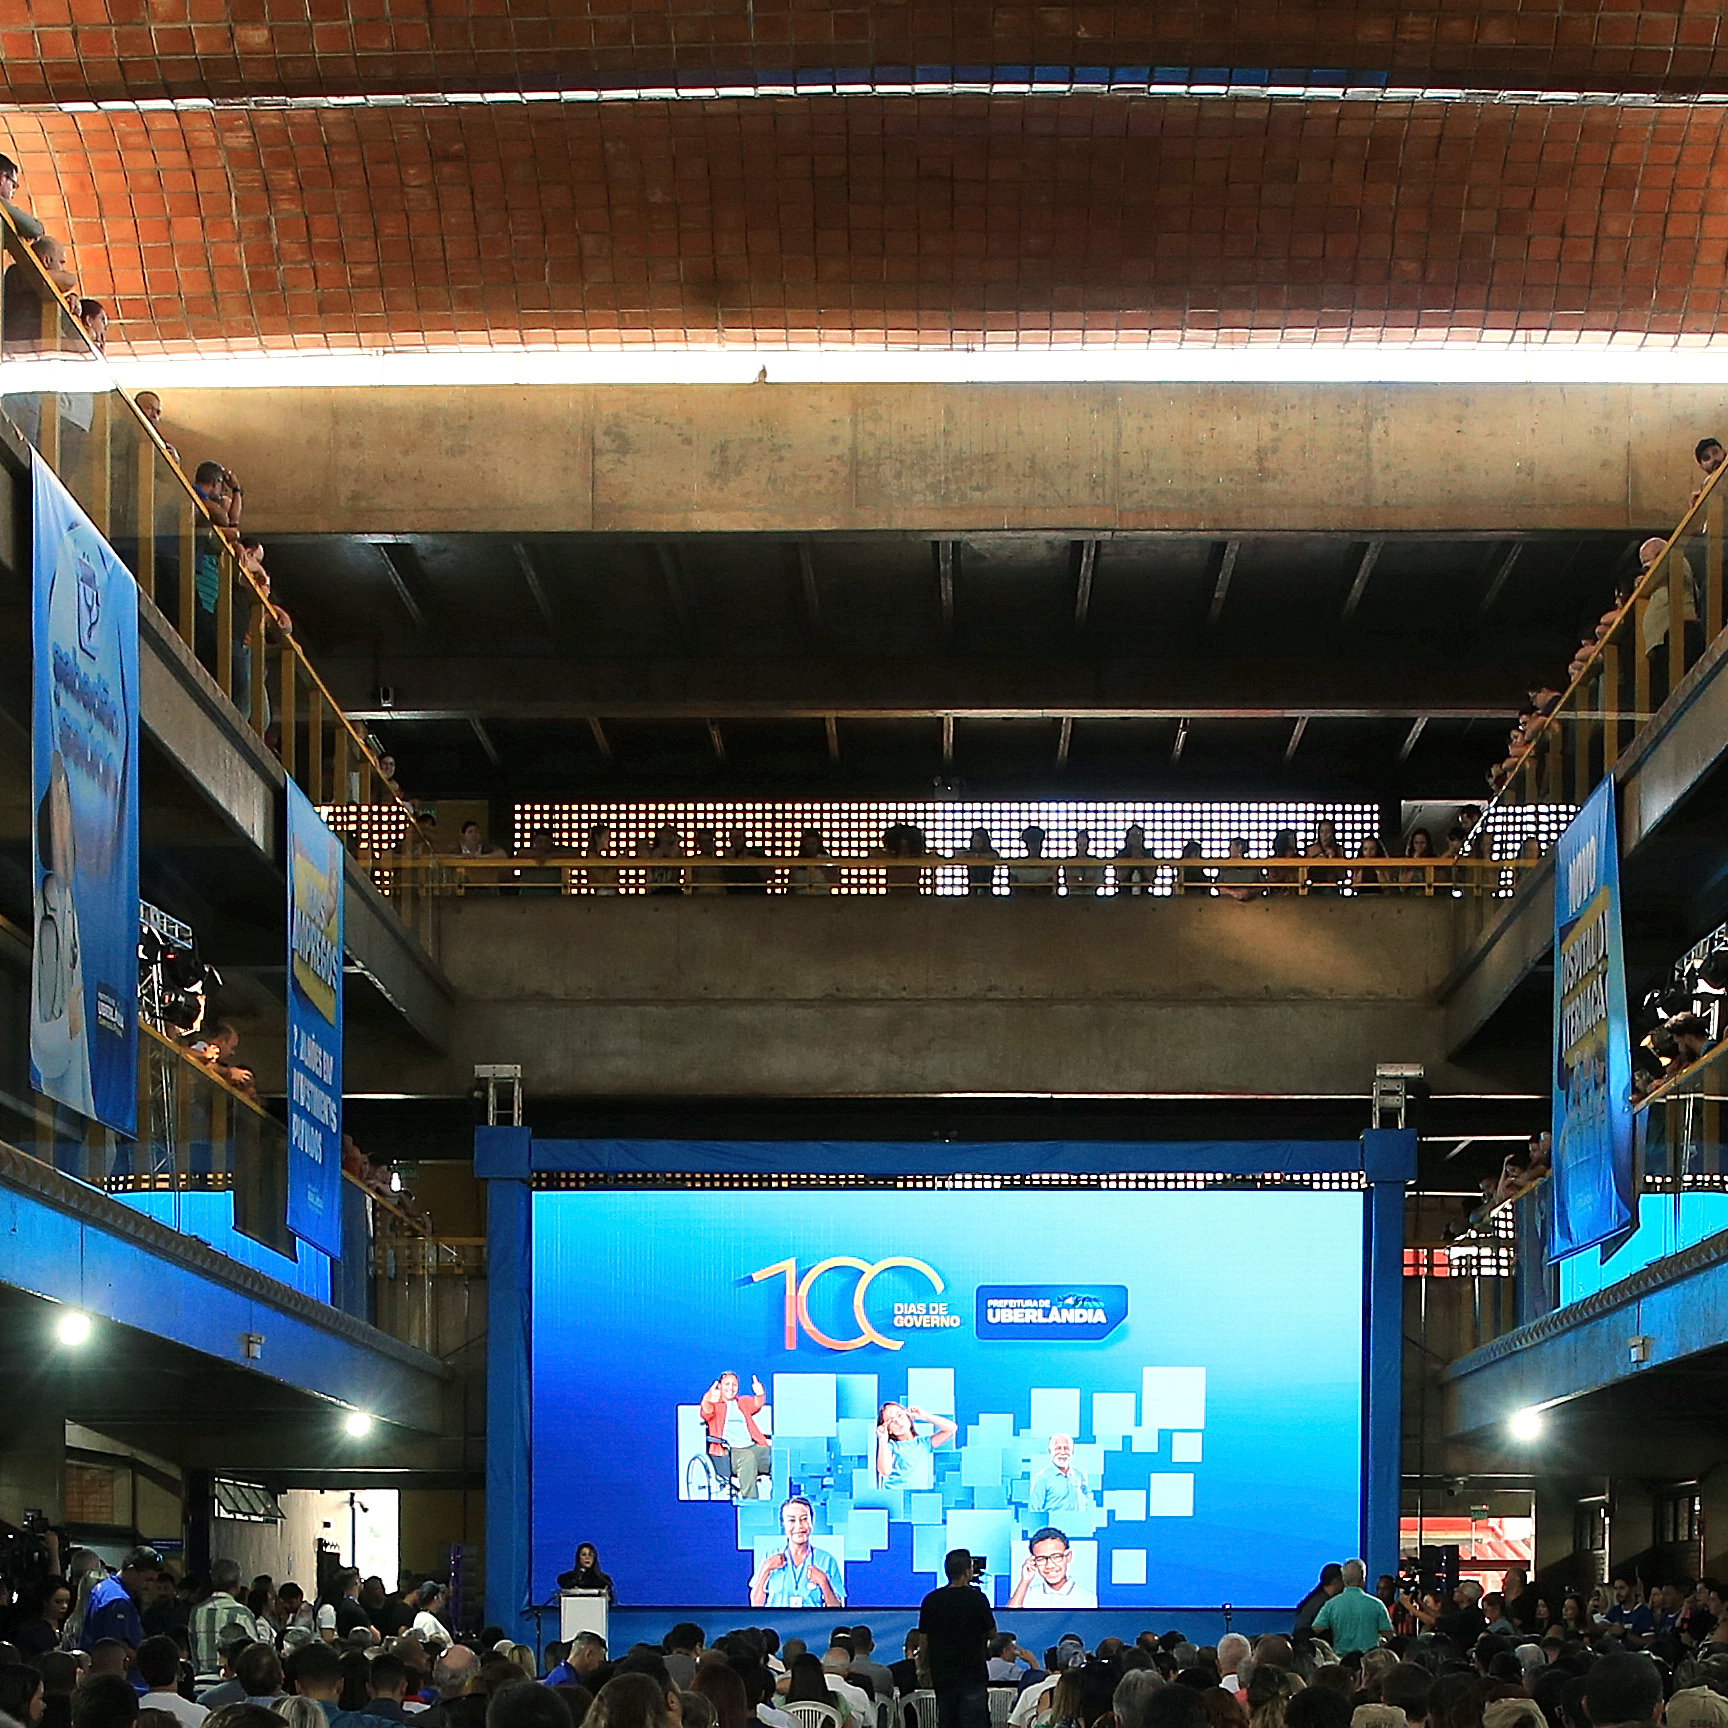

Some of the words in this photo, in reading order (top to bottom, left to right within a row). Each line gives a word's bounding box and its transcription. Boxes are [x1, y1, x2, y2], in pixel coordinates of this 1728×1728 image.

[1560, 920, 1597, 998] OSPITAL
[894, 1302, 926, 1317] DIAS
[929, 1302, 948, 1317] DE
[987, 1299, 1038, 1309] PREFEITURA
[1040, 1299, 1051, 1309] DE
[894, 1315, 961, 1329] GOVERNO
[987, 1305, 1107, 1324] UBERLÂNDIA
